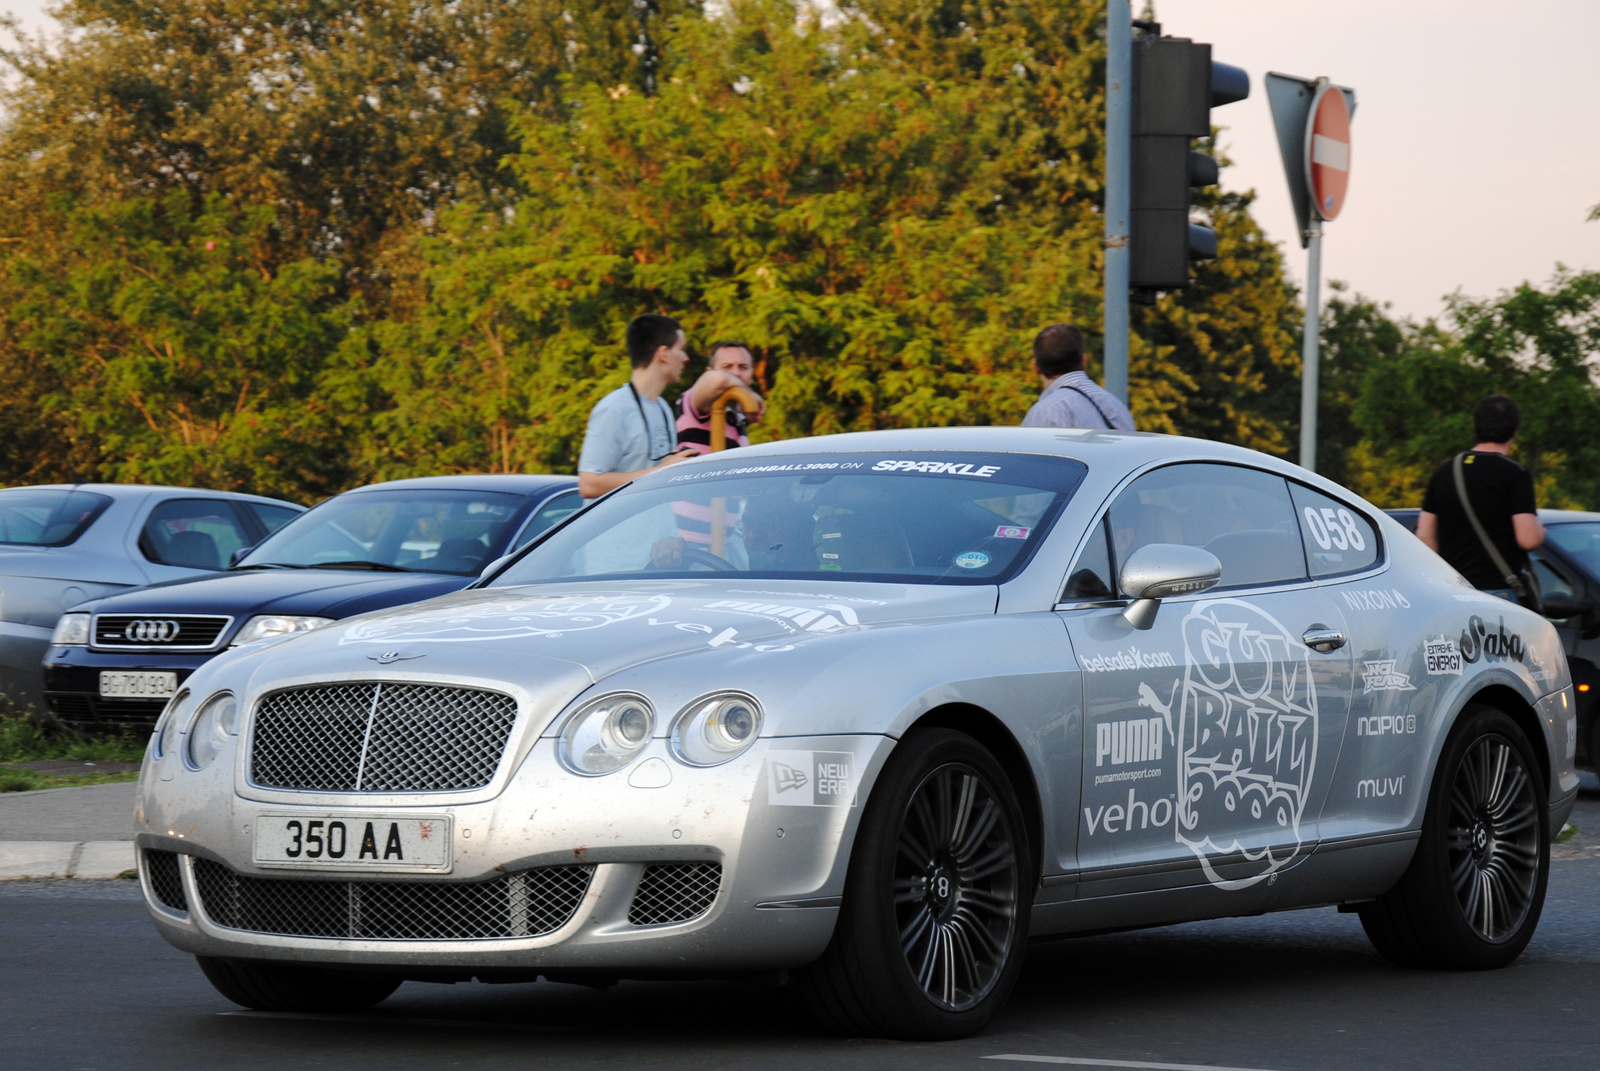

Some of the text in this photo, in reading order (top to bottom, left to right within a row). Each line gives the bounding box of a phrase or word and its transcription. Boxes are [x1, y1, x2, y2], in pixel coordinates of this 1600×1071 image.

[668, 470, 726, 483] FOLLOW
[840, 462, 864, 470] ON
[871, 460, 1002, 477] SPARKLE
[1303, 506, 1366, 551] 058
[1341, 589, 1398, 611] NIXON
[1427, 643, 1453, 655] EXTREME
[1460, 614, 1525, 664] Saba
[1369, 663, 1392, 675] NO
[1428, 655, 1461, 671] ENERGY
[1366, 675, 1409, 690] FEAR
[1096, 717, 1163, 767] PUMA
[818, 763, 849, 779] NEW
[1094, 767, 1162, 786] pumamotorsport.com
[818, 779, 849, 795] ERA
[1084, 788, 1173, 836] veho
[285, 820, 404, 860] 350 AA
